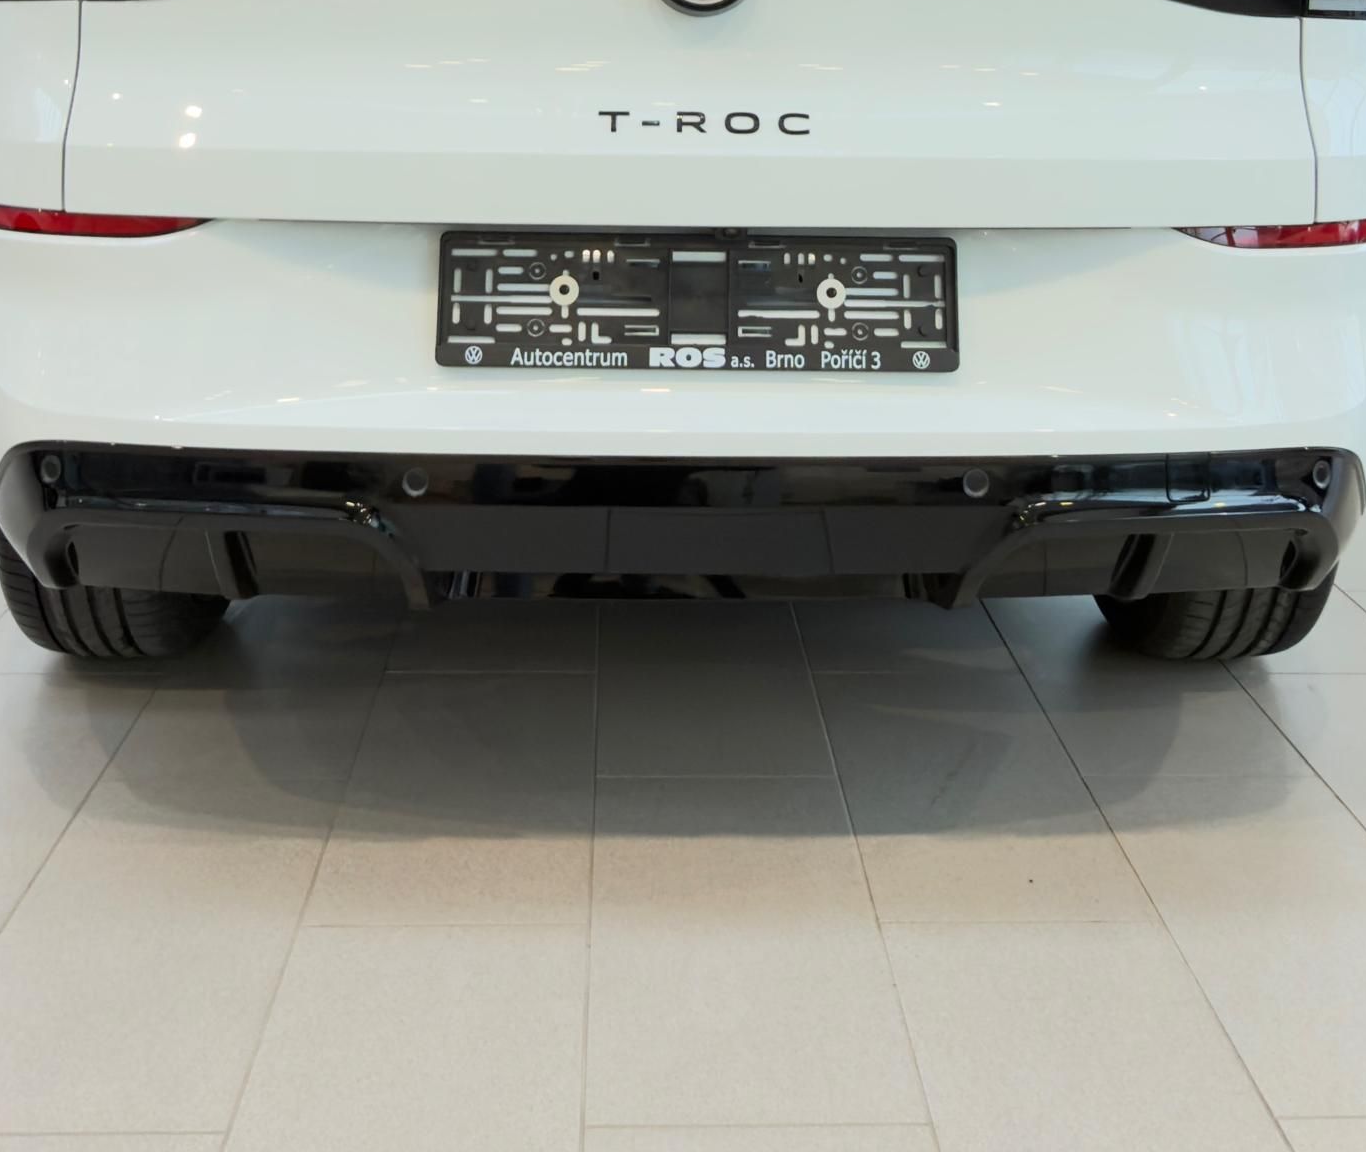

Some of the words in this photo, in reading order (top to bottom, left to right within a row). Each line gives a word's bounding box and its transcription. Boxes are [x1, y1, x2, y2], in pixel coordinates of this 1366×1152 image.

[598, 110, 810, 135] T-ROC
[510, 347, 628, 367] Autocentrum
[649, 347, 726, 368] ROS
[730, 354, 755, 368] a.s.
[765, 350, 805, 369] Brno
[821, 349, 867, 370] Poříčí
[871, 351, 882, 369] 3
